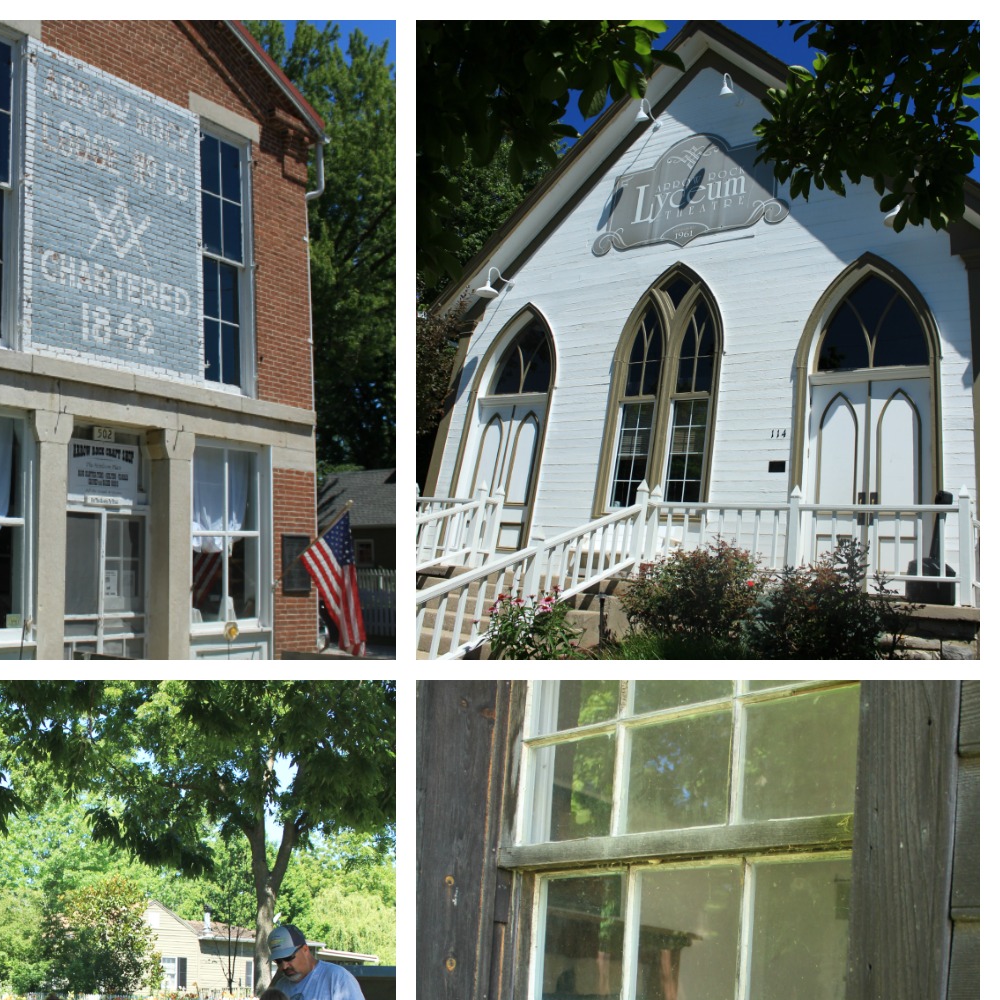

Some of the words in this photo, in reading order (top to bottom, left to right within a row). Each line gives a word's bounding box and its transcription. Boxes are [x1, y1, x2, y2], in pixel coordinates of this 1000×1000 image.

[40, 111, 121, 176] LODGE
[135, 107, 190, 153] ROCK
[656, 175, 702, 194] ARROW
[708, 167, 745, 182] ROCK
[630, 175, 748, 225] Lyceum
[664, 195, 745, 220] THEATRE
[675, 230, 693, 240] 1961
[41, 249, 191, 318] CHARTERED
[81, 301, 155, 355] 1842
[97, 429, 112, 440] 502
[770, 429, 787, 439] 114
